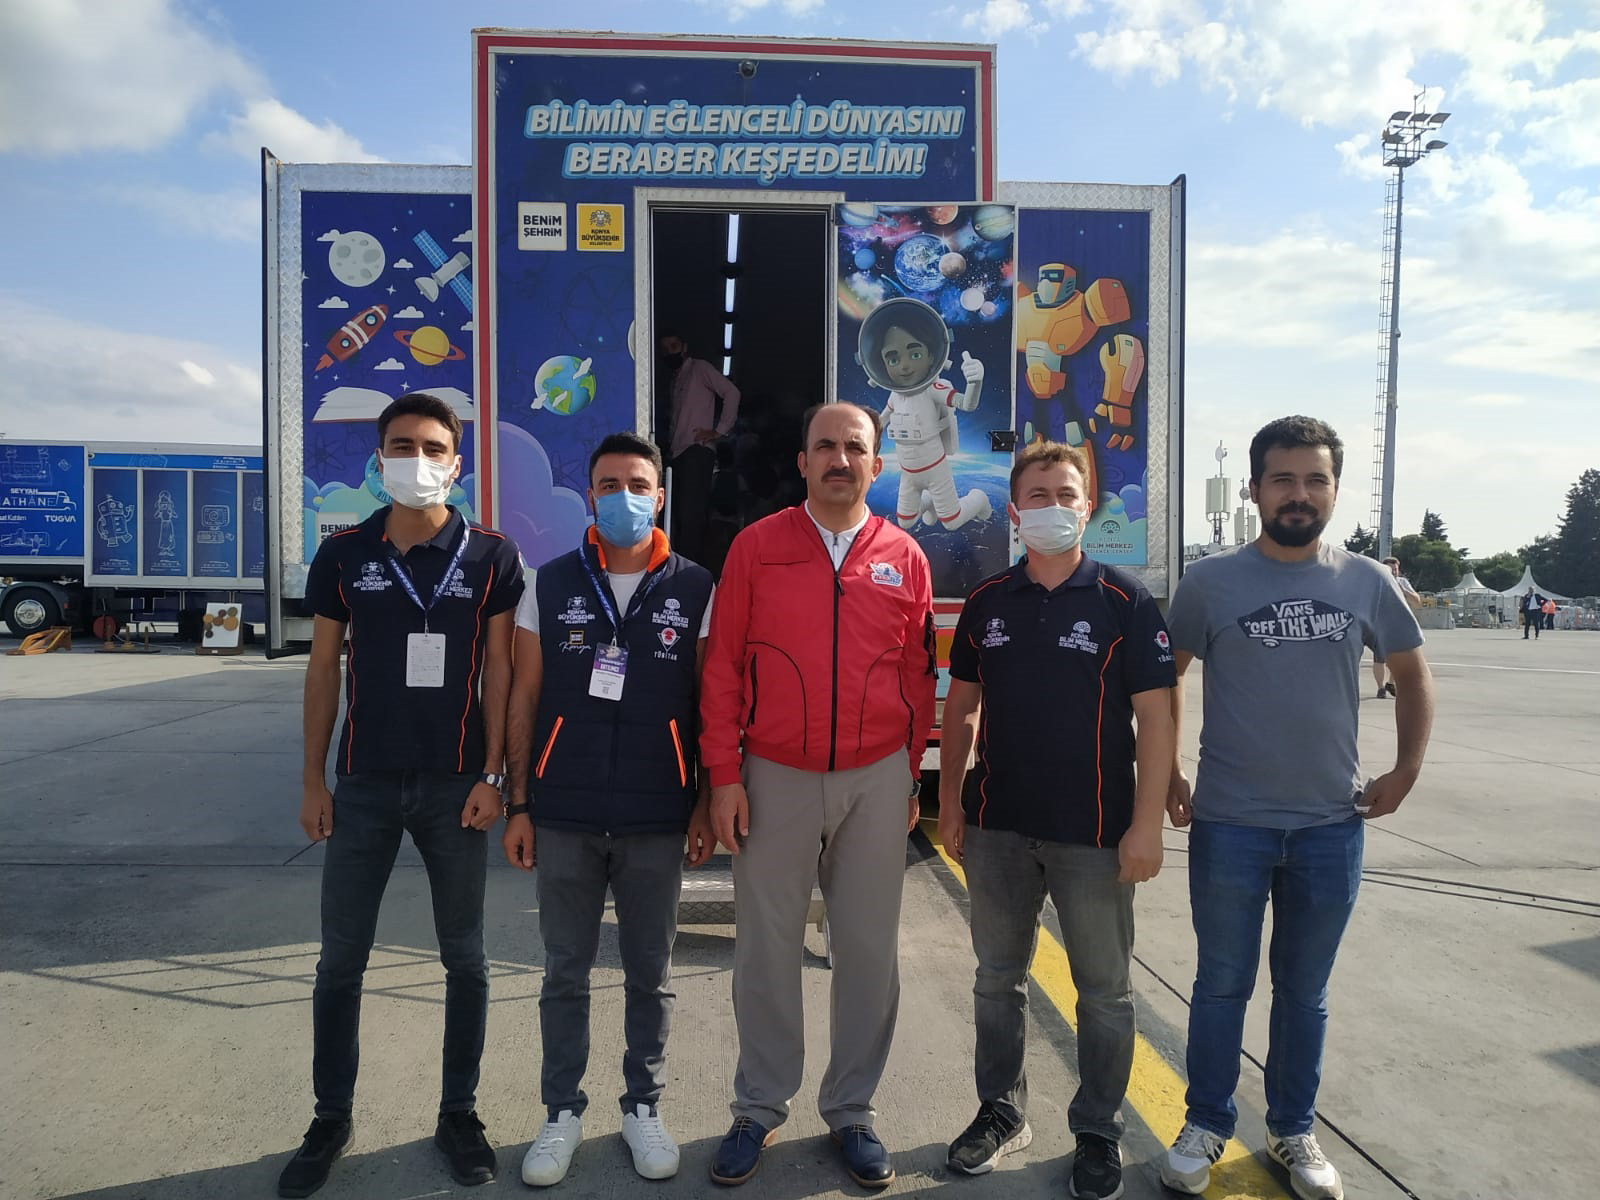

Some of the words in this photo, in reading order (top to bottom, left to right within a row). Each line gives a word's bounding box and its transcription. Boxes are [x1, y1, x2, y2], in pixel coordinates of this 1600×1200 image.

[529, 102, 645, 134] BİLİMİN
[648, 102, 804, 134] EĞLENCELİ
[806, 103, 963, 135] DÜNYASINI
[567, 146, 715, 174] BERABER
[720, 140, 927, 180] KEŞFEDELİM!
[1271, 599, 1315, 619] VANS
[1277, 616, 1310, 637] THE
